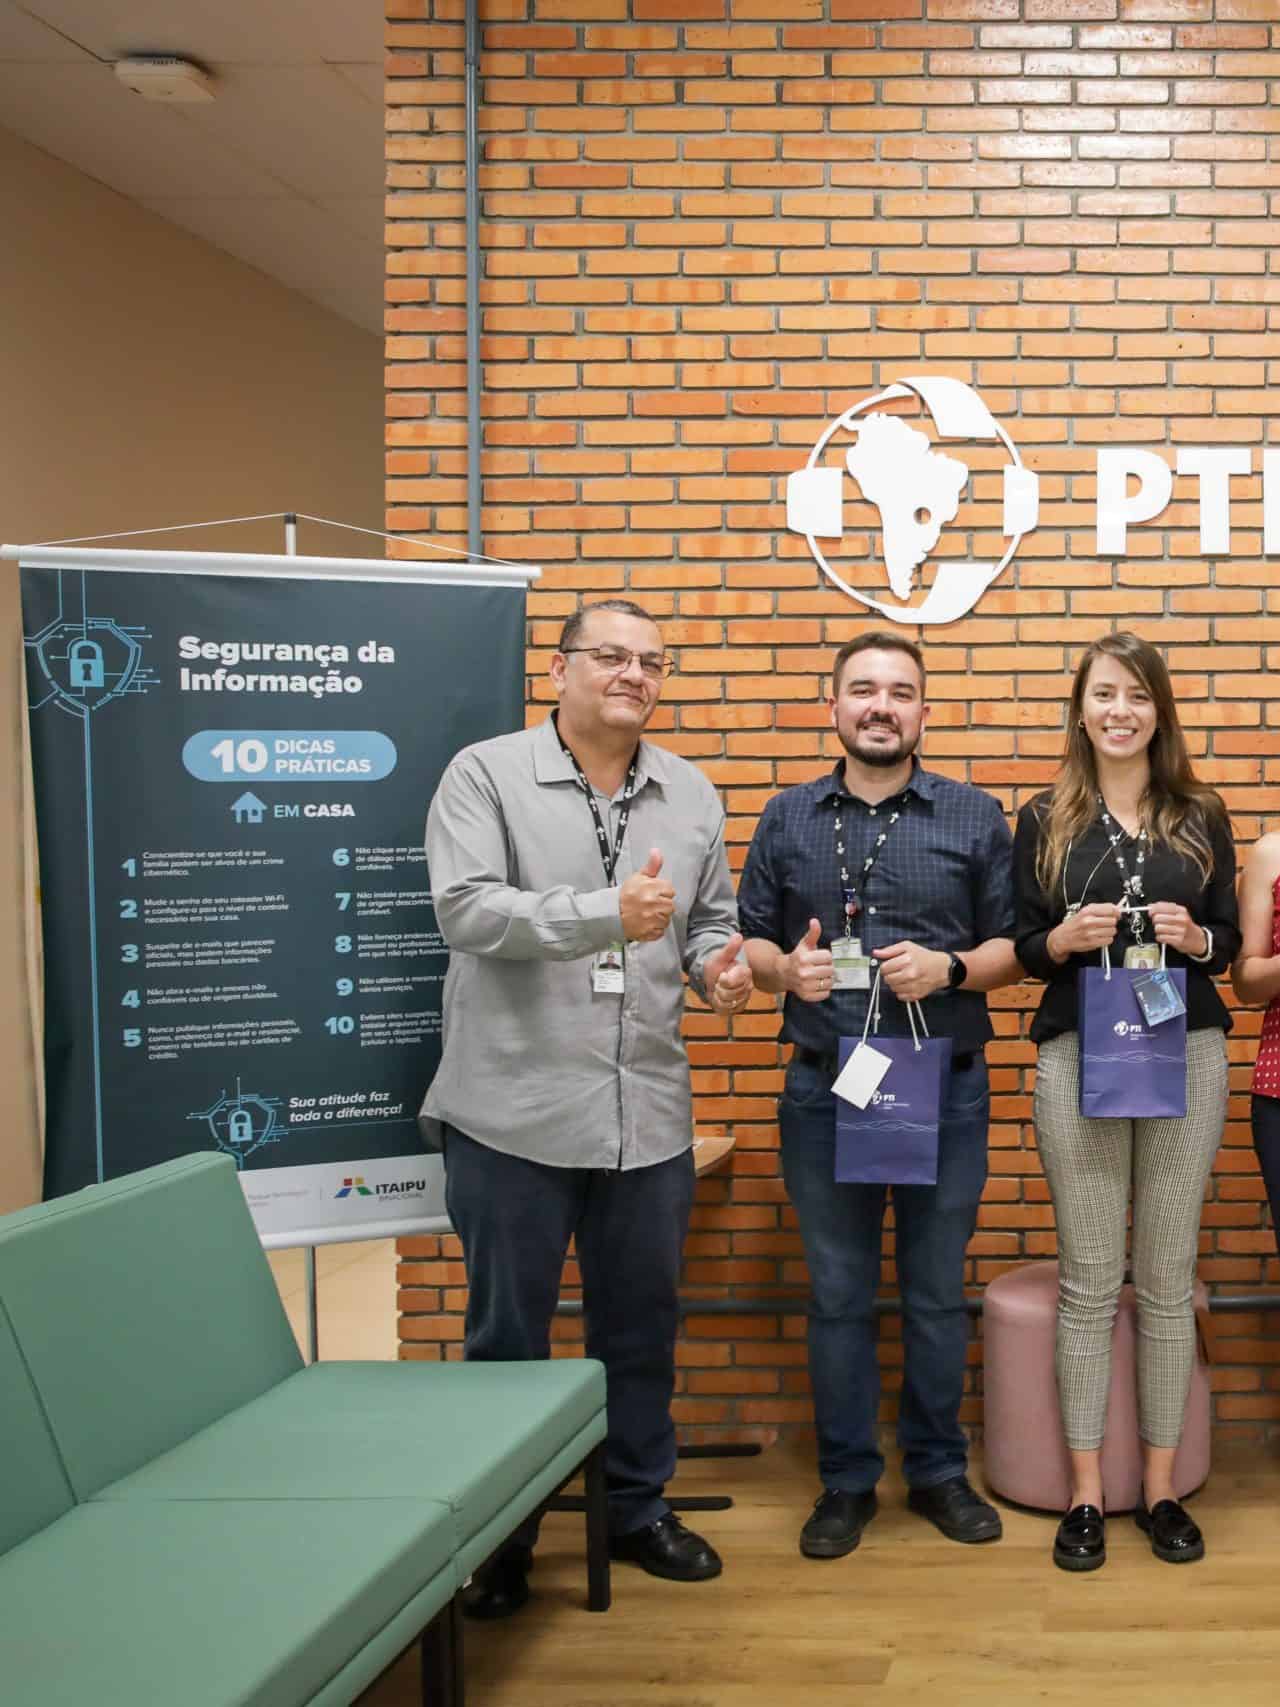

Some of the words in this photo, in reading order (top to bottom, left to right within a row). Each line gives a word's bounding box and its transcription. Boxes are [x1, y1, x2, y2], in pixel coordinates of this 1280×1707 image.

[179, 636, 348, 667] Segurança
[358, 641, 394, 663] da
[181, 668, 362, 698] Informação
[211, 740, 268, 772] 10
[275, 740, 335, 754] DICAS
[276, 756, 371, 773] PRÁTICAS
[274, 805, 299, 817] EM
[304, 804, 355, 817] CASA
[333, 848, 349, 866] 6
[122, 859, 135, 877] 1
[120, 900, 137, 918] 2
[335, 893, 350, 910] 7
[121, 944, 138, 962] 3
[335, 936, 352, 952] 8
[336, 978, 353, 996] 9
[122, 990, 140, 1008] 4
[325, 1016, 354, 1034] 10
[124, 1029, 141, 1047] 5
[289, 1098, 316, 1108] Sua
[319, 1093, 365, 1106] atitude
[370, 1092, 389, 1101] faz
[290, 1111, 321, 1122] toda
[336, 1103, 402, 1118] diferença!
[376, 1180, 426, 1194] ITAIPU
